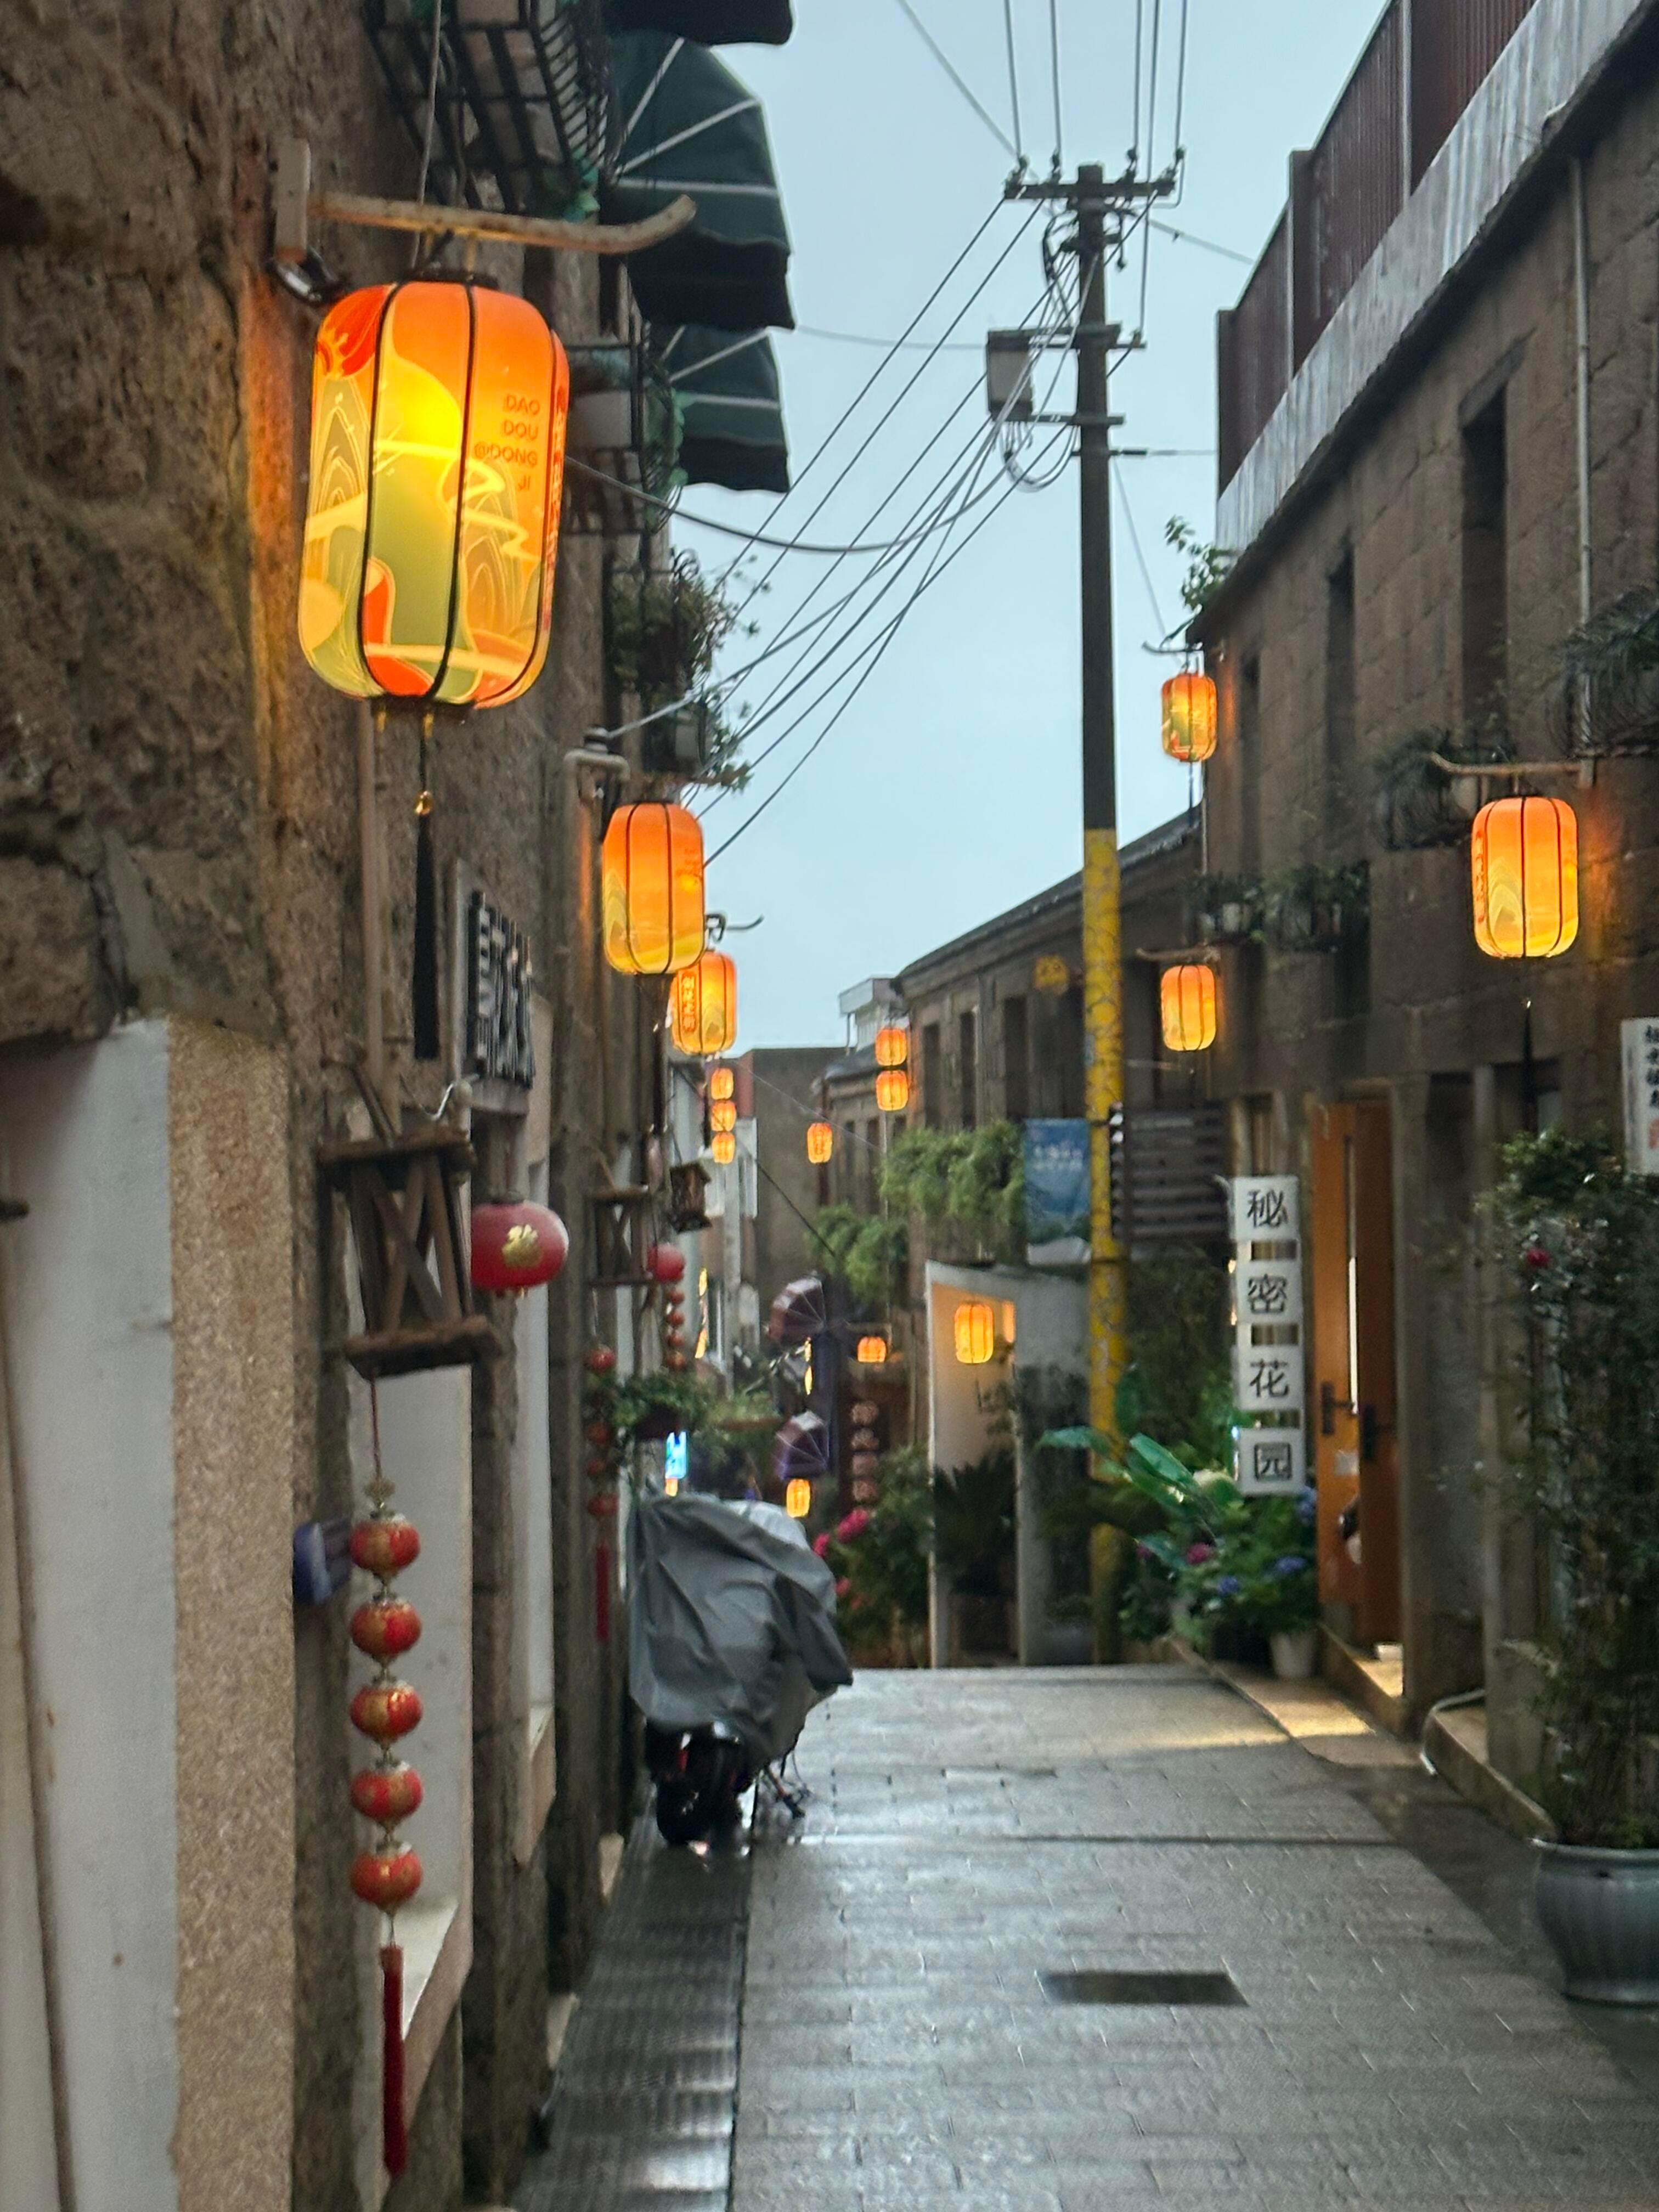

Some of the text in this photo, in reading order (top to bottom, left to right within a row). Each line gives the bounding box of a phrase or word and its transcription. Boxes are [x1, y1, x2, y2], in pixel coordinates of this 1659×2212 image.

[506, 393, 540, 415] DAO
[504, 419, 538, 441] DOU
[518, 475, 531, 492] JI
[1246, 1188, 1292, 1481] 秘密花园
